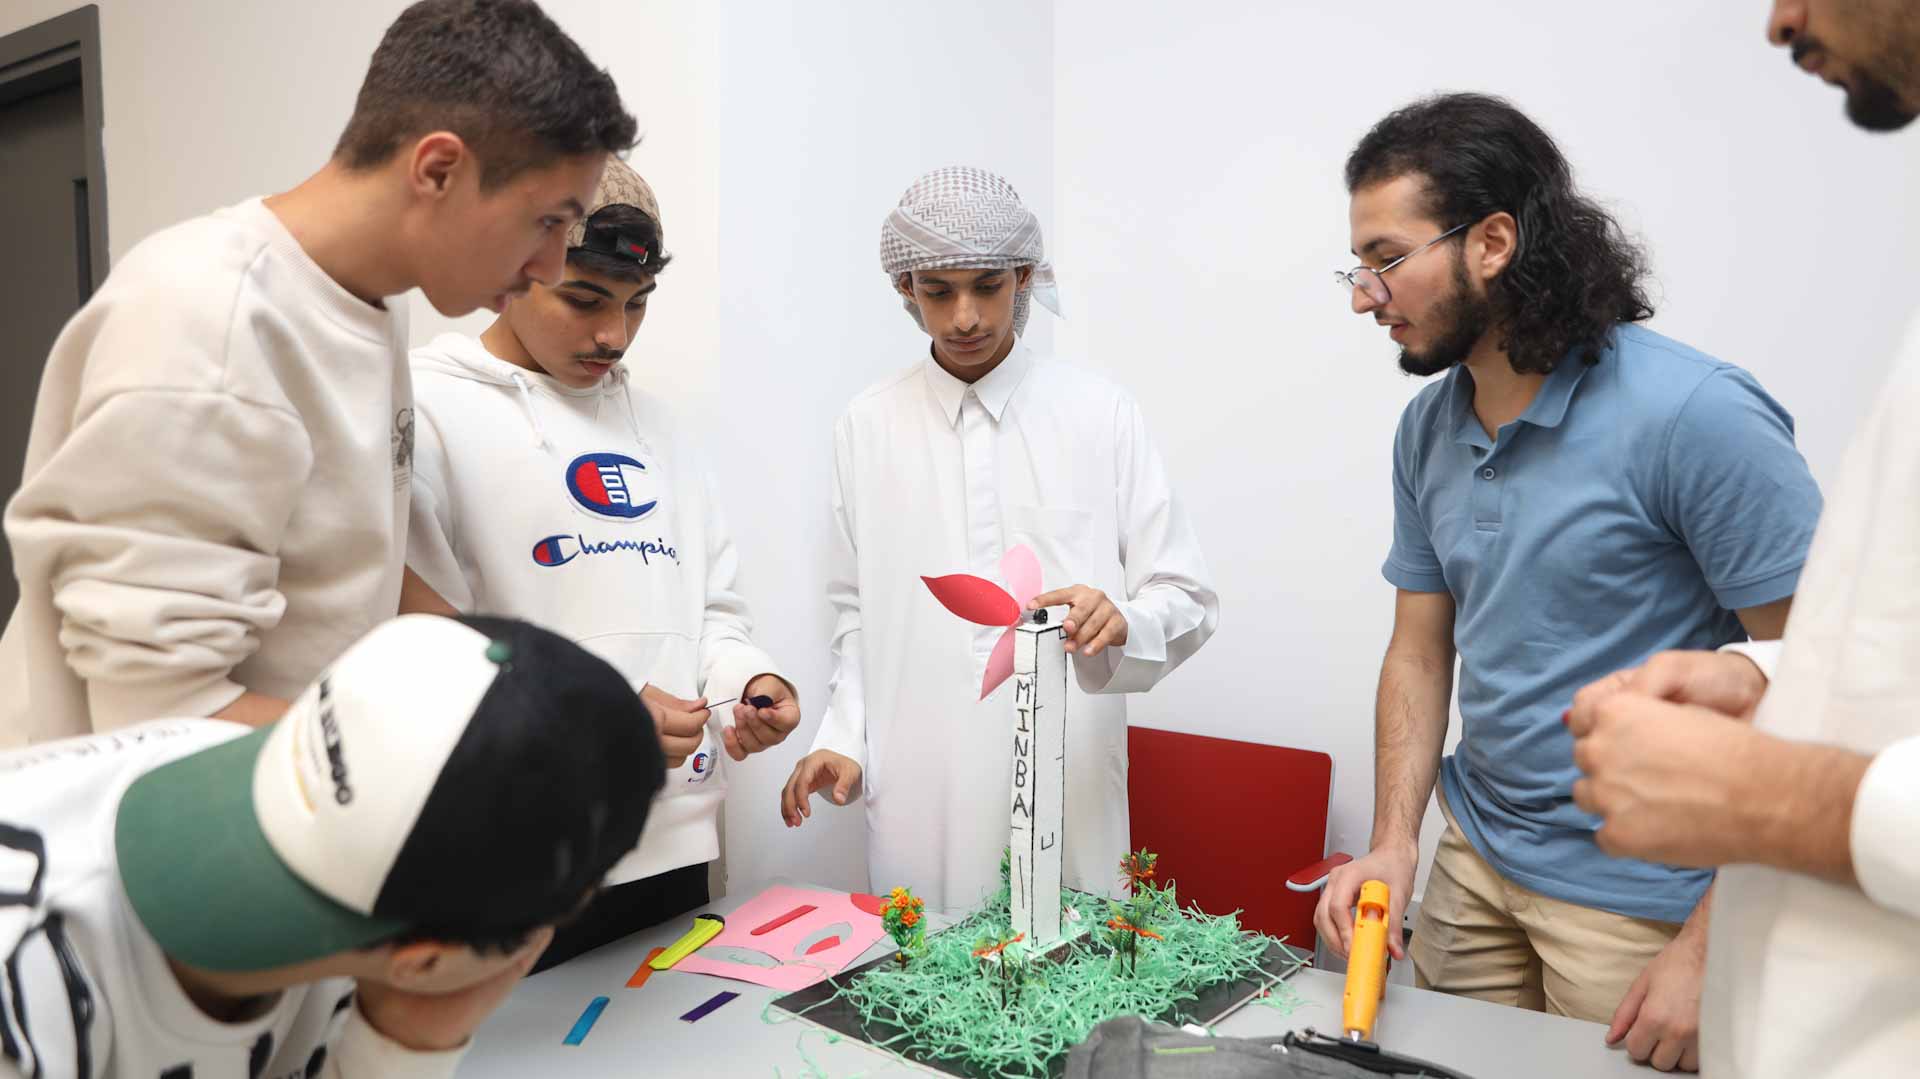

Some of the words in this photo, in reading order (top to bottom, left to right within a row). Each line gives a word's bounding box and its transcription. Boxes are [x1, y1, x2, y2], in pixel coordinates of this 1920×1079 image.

[598, 465, 628, 503] 100
[532, 533, 681, 567] Champio
[1012, 679, 1031, 818] MINBA
